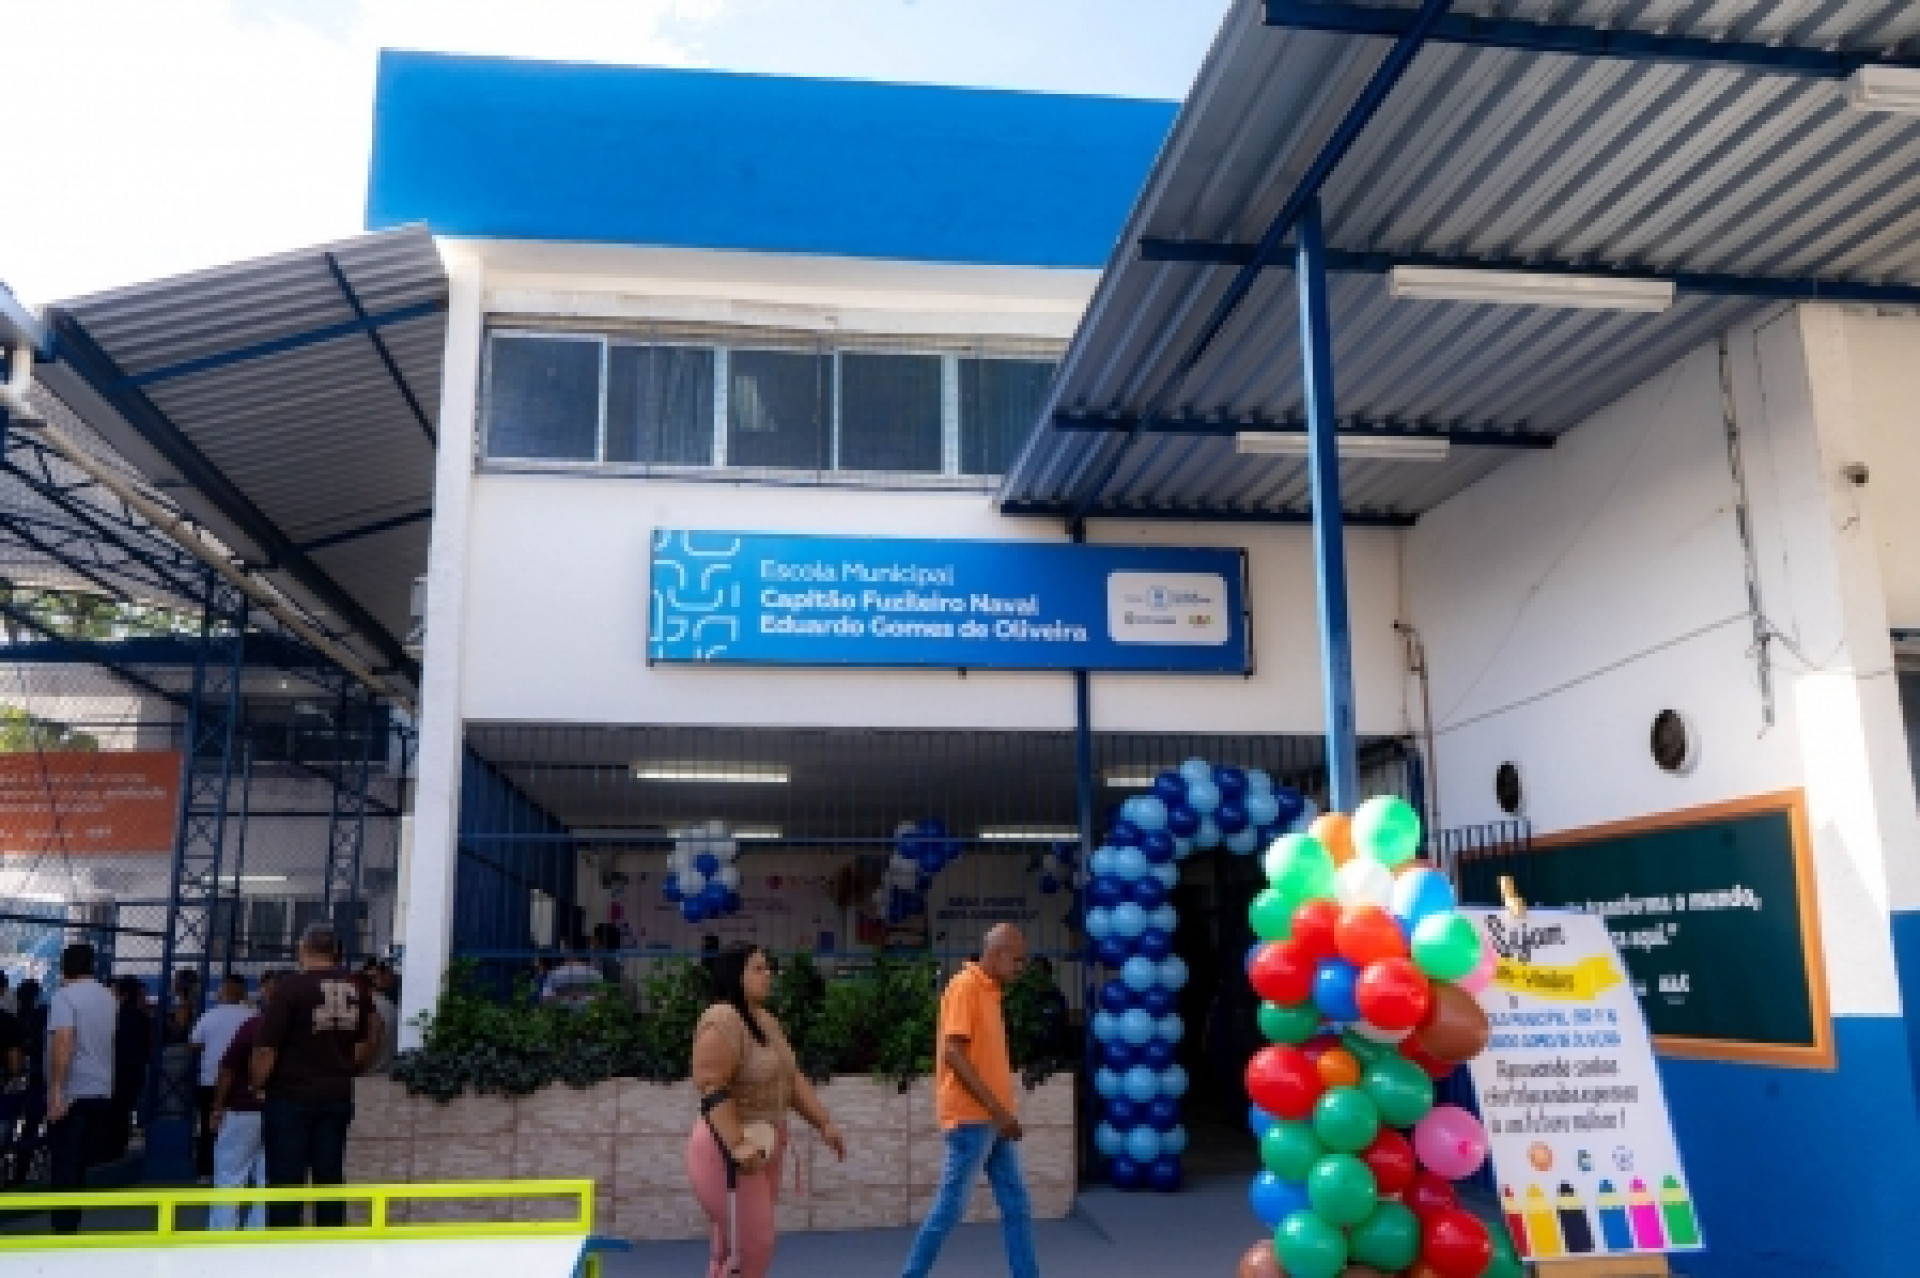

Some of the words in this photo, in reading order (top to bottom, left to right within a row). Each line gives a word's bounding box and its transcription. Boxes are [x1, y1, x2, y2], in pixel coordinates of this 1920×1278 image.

[760, 558, 837, 584] Escola
[841, 560, 954, 588] Municipal
[760, 588, 856, 615] Capitão
[863, 589, 965, 614] Fuzileiro
[970, 593, 1039, 616] Naval
[760, 613, 864, 636] Eduardo
[870, 615, 951, 638] Gomes
[958, 617, 988, 639] de
[995, 618, 1090, 643] Oliveira
